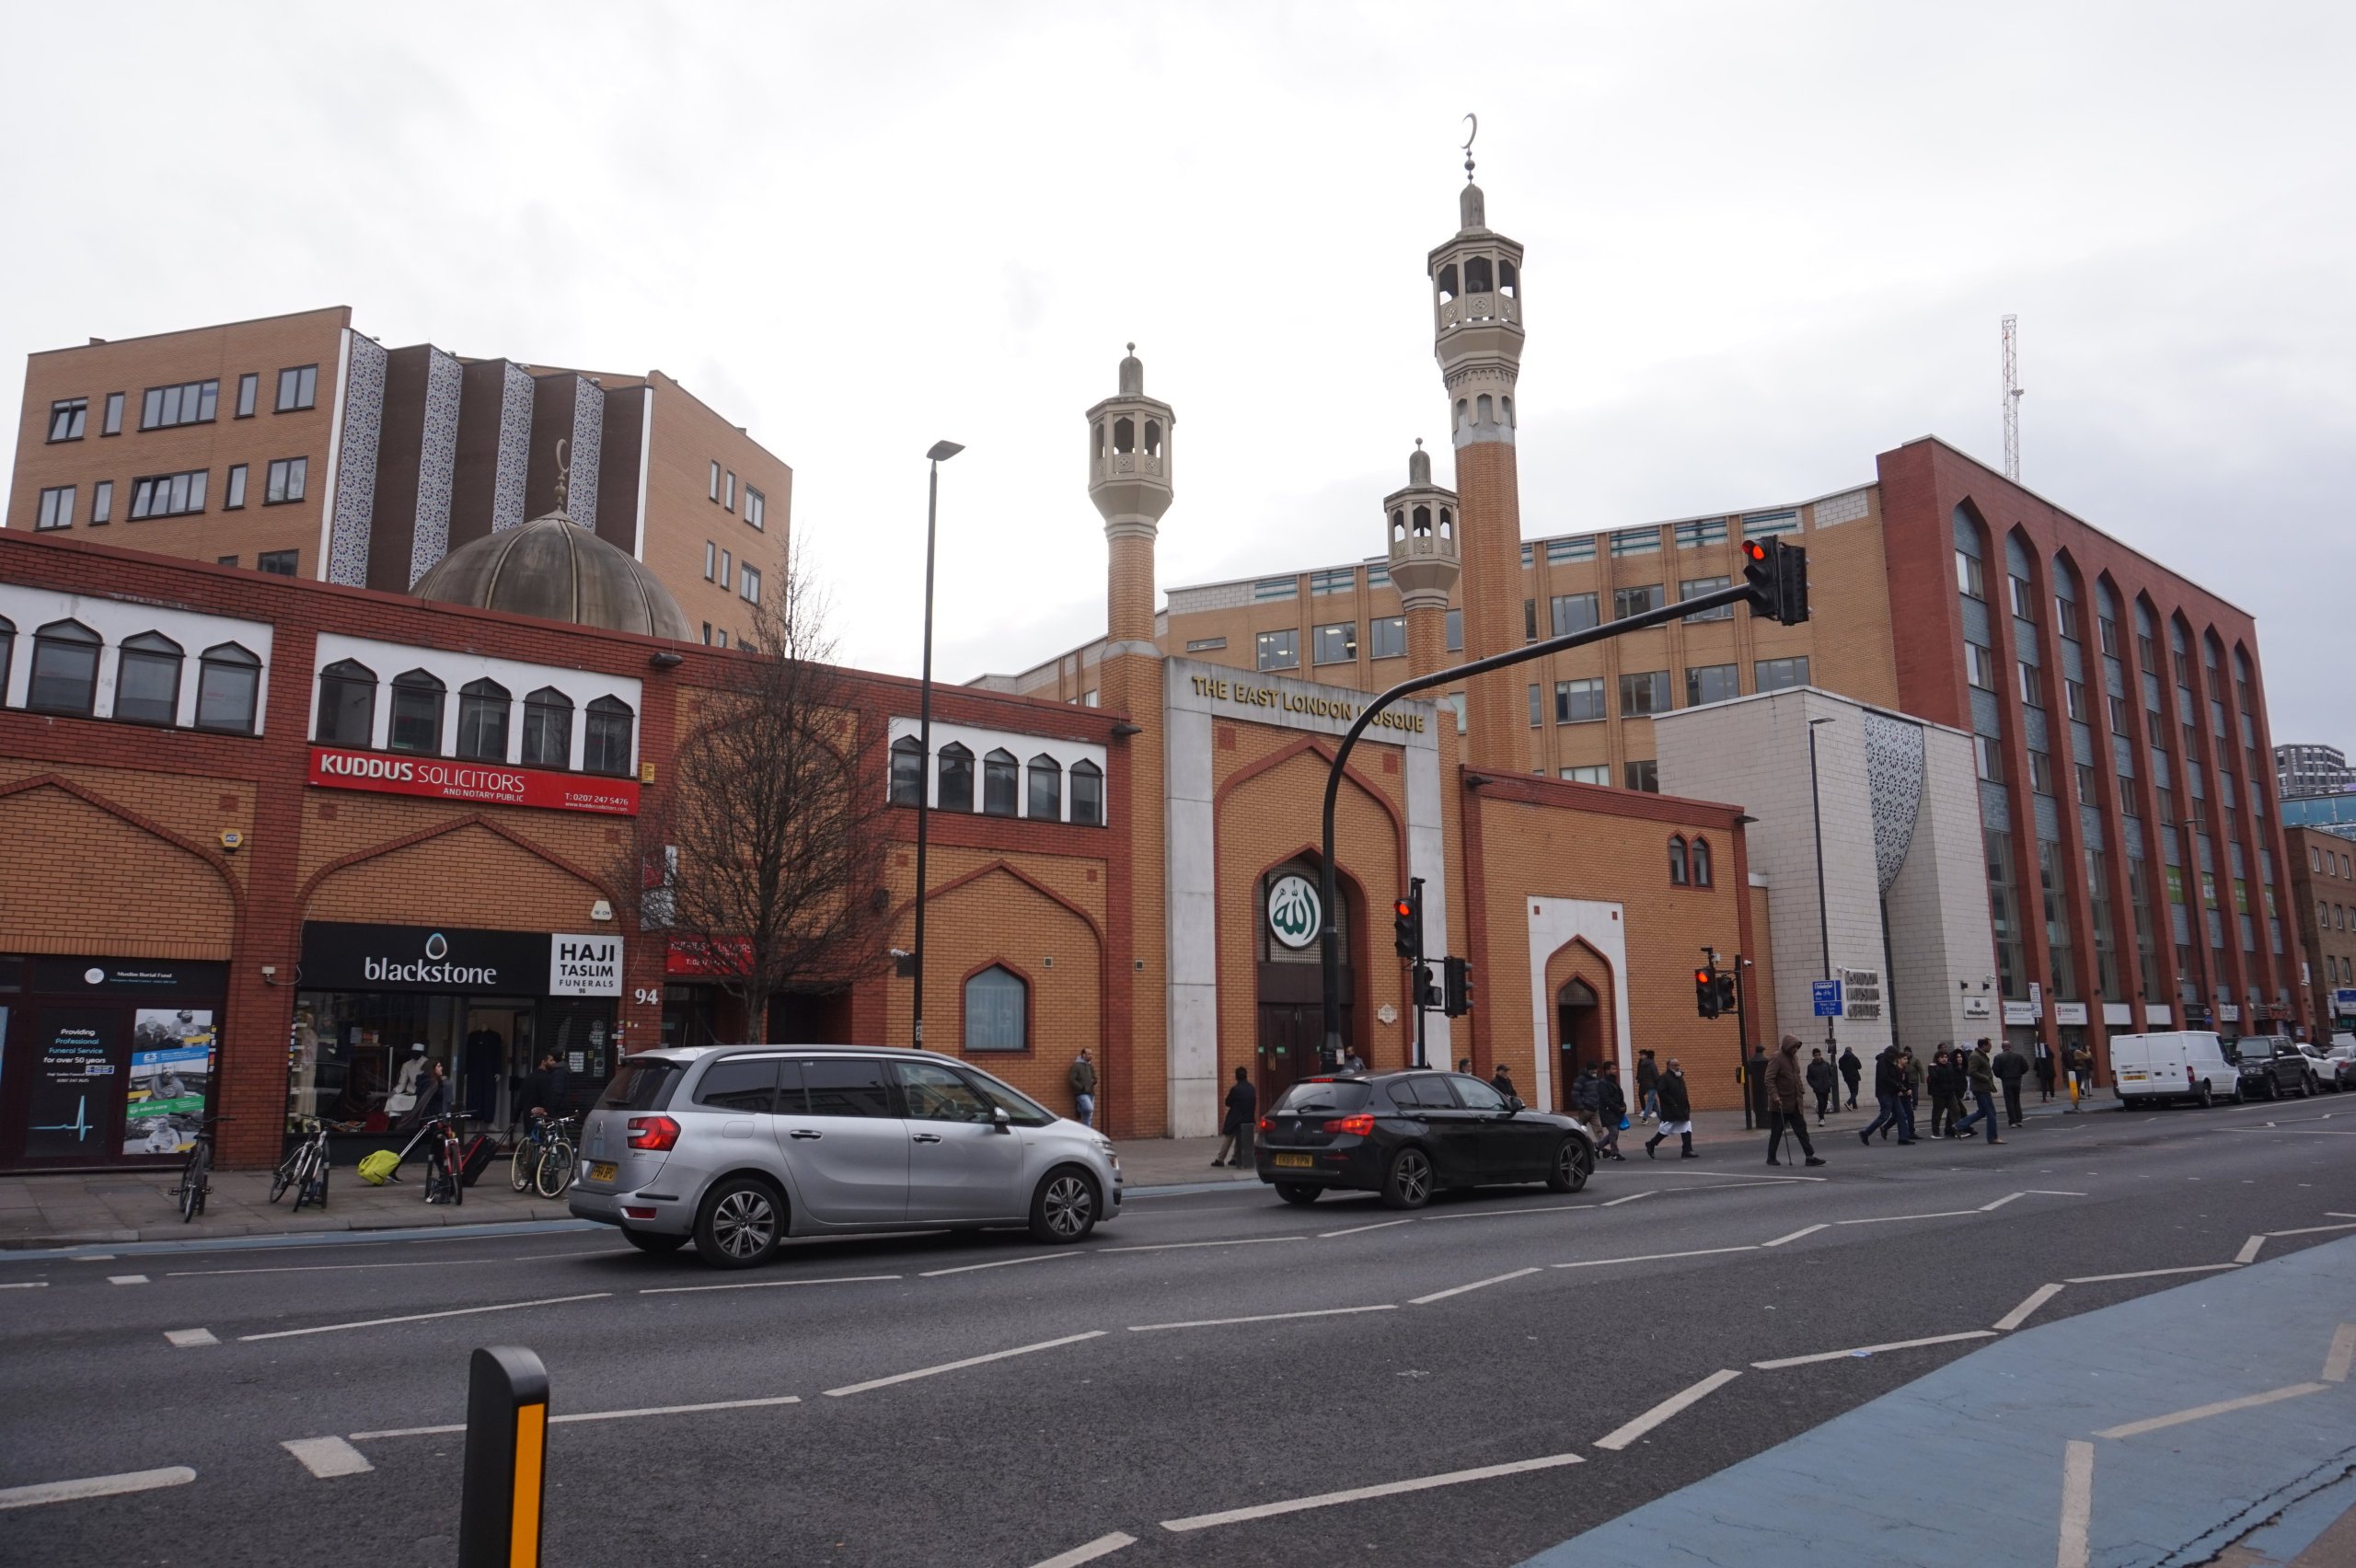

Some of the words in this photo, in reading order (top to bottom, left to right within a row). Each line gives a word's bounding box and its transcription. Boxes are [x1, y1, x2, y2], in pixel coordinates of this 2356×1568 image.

[1192, 675, 1228, 700] THE
[1235, 684, 1279, 708] EAST
[1283, 692, 1352, 721] LONDON
[1357, 706, 1425, 732] OSQUE
[320, 754, 413, 781] KUDDUS
[418, 766, 525, 793] SOLICITORS
[443, 788, 462, 796] AND
[463, 790, 494, 800] NOTARY
[496, 792, 524, 802] PUBLIC
[573, 793, 593, 802] 0207
[595, 795, 608, 804] 247
[609, 797, 629, 805] 5476
[560, 943, 615, 962] HAJI
[364, 956, 497, 985] blackstone
[560, 964, 614, 977] TASLIM
[559, 979, 614, 987] FUNERALS
[635, 988, 658, 1005] 94
